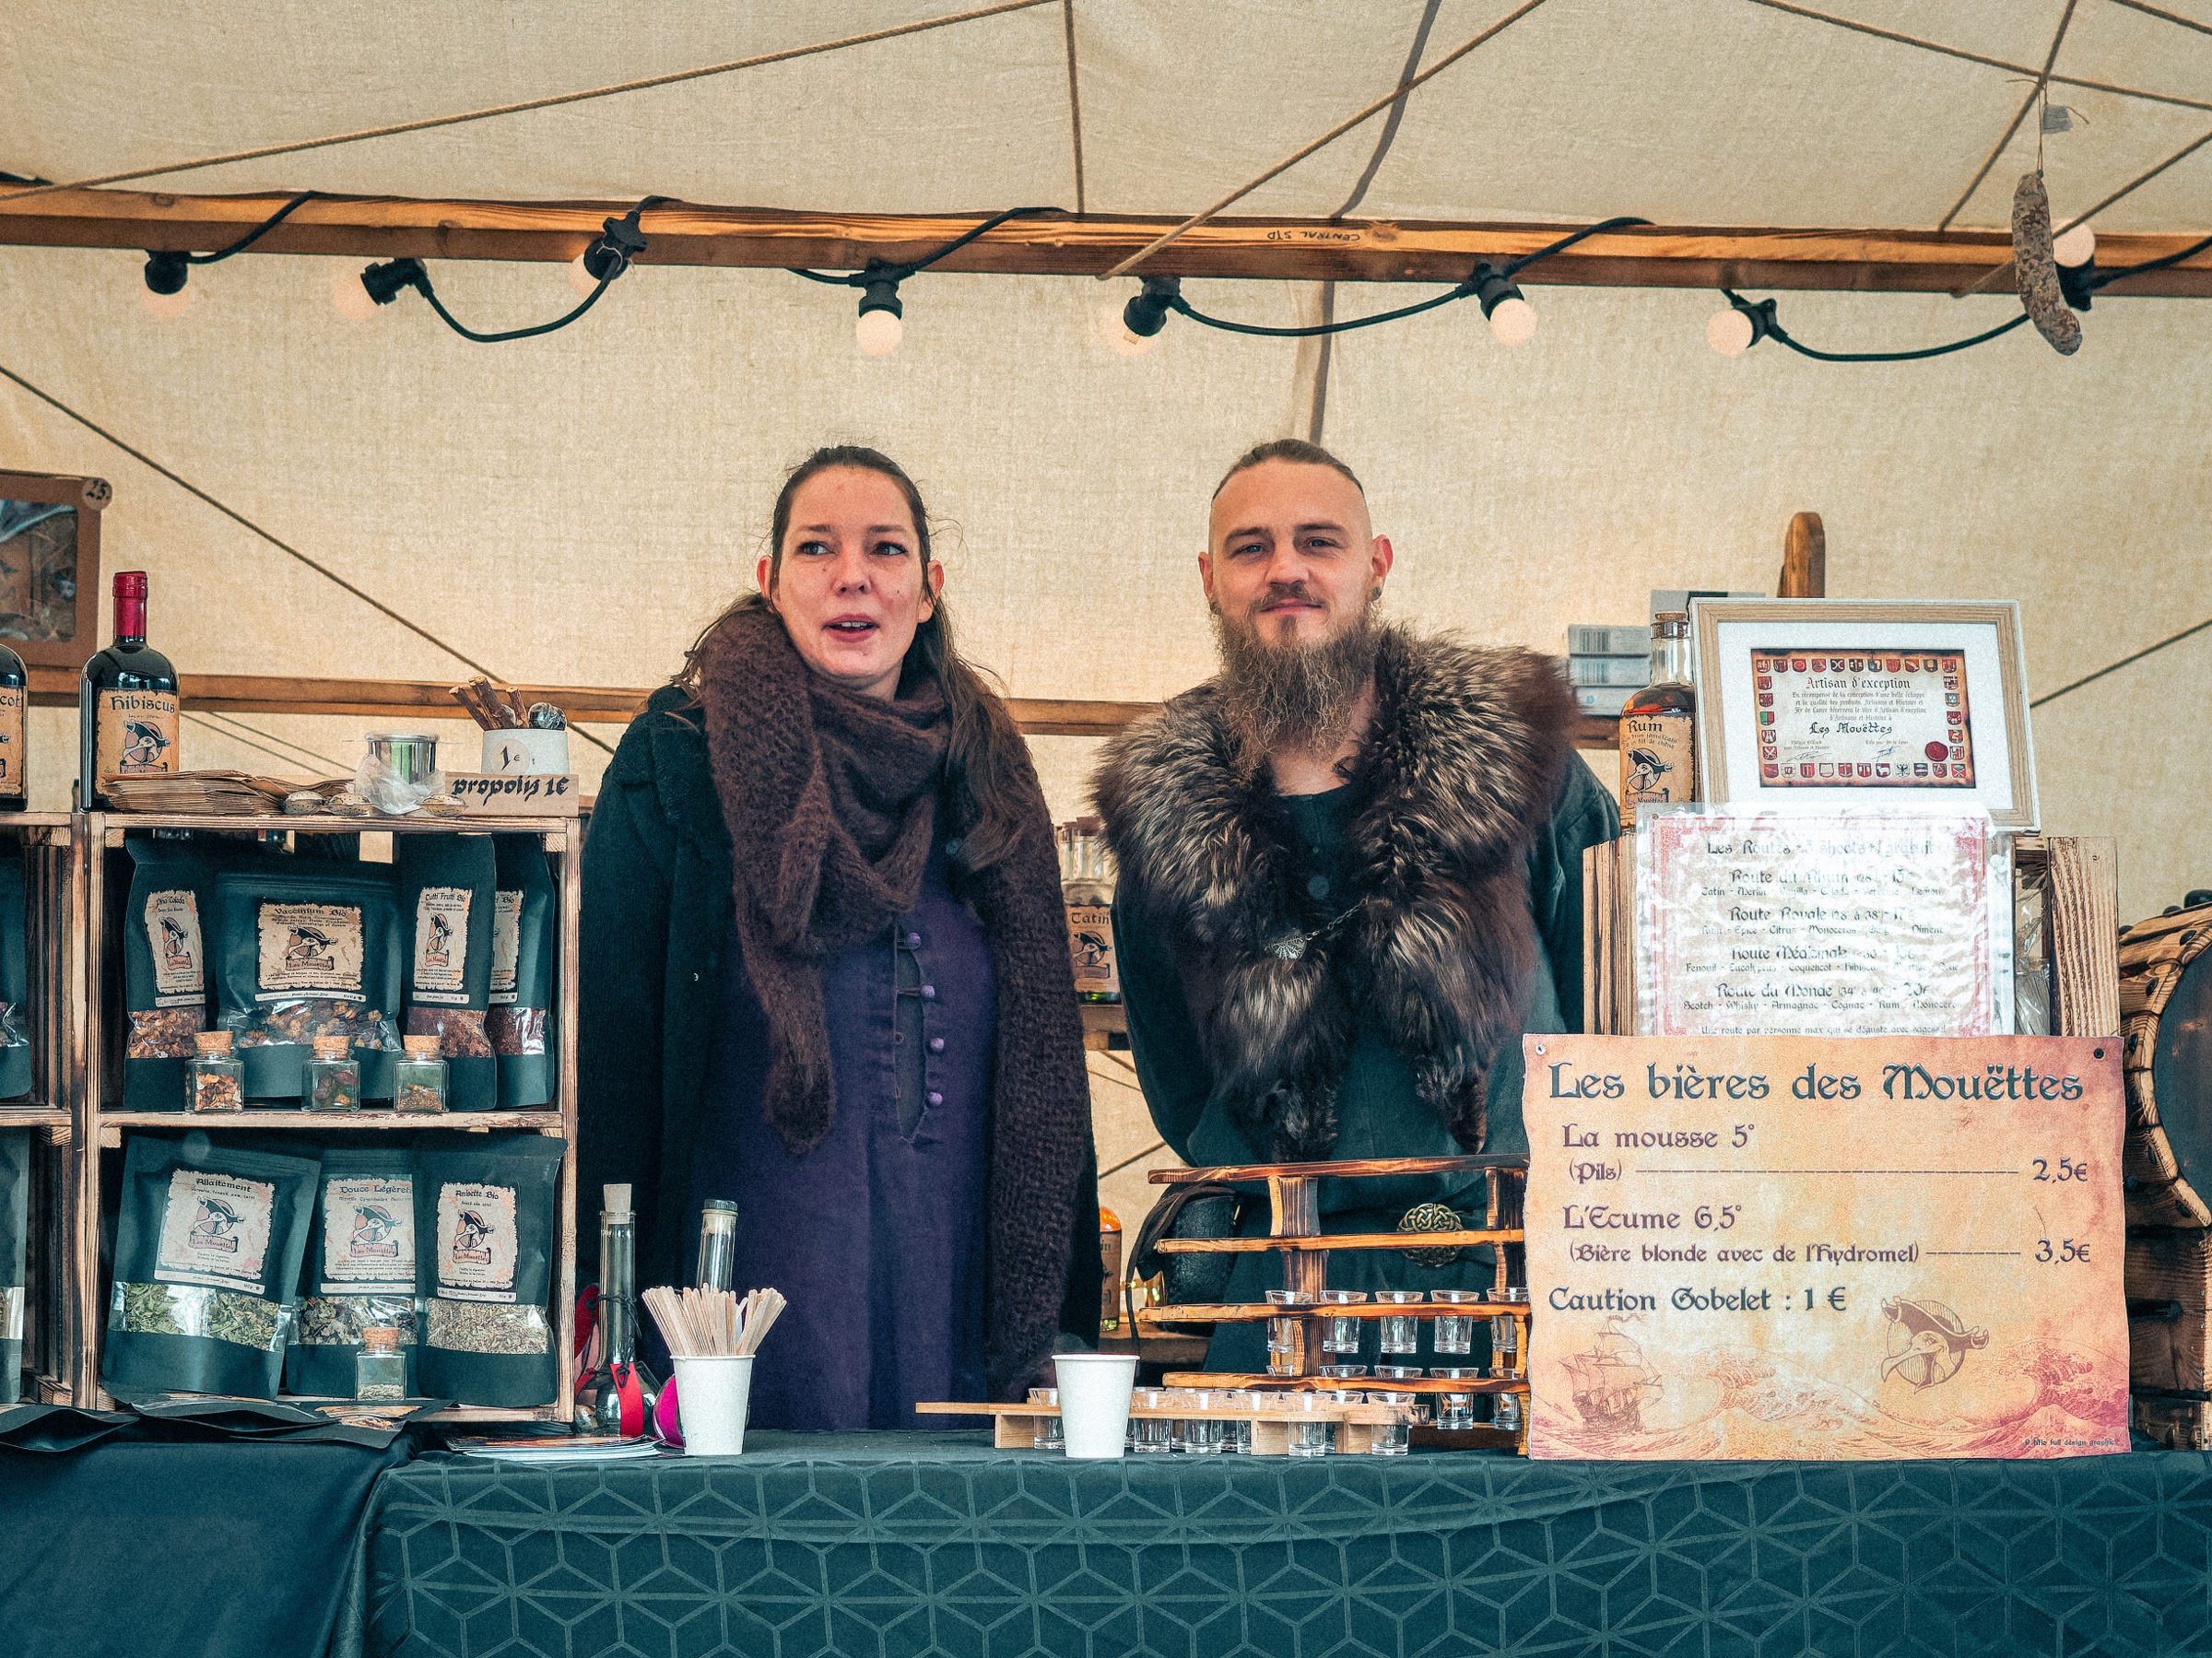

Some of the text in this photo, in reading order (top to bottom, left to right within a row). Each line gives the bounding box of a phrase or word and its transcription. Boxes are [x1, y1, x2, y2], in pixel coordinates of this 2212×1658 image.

[1299, 230, 1361, 241] CENTRAL
[1806, 676, 1911, 691] Artisan d'exception
[1626, 719, 1663, 734] Rum
[1809, 722, 1830, 738] Les
[451, 775, 570, 806] propolis 1€
[1708, 840, 1733, 855] Les
[1742, 839, 1791, 855] Routes
[1730, 868, 1772, 884] Route
[1779, 869, 1797, 884] du
[1701, 887, 1725, 896] Tatin
[1070, 911, 1110, 924] Tatin
[1729, 906, 1771, 922] Route
[1769, 924, 1796, 935] Citrus
[1732, 945, 1771, 959] Route
[1775, 945, 1848, 960] Médicinale
[1686, 962, 1717, 972] Fenouil
[1788, 962, 1832, 973] Coquelicot
[1715, 982, 1757, 998] Route
[1761, 982, 1779, 998] du
[1784, 982, 1832, 998] Monde
[1683, 1000, 1713, 1010] Scotch
[1725, 1001, 1759, 1012] Whisky
[1771, 1001, 1818, 1012] Armagnac
[1830, 1000, 1865, 1012] Cognac
[1878, 1000, 1900, 1010] Rum
[1701, 1025, 1718, 1035] Une
[1721, 1026, 1744, 1035] route
[1747, 1026, 1760, 1036] par
[1805, 1026, 1824, 1035] max
[1827, 1025, 1841, 1036] qui
[1855, 1024, 1888, 1036] déguste
[1890, 1026, 1909, 1034] avec
[1547, 1061, 2084, 1100] Les bières des Mouëttes
[1561, 1123, 1756, 1148] La mousse 5°
[1569, 1156, 2088, 1184] (Pils) 2,5€
[196, 1177, 253, 1193] Allaitement
[1562, 1204, 1742, 1232] L'Ecume 6,5°
[1570, 1240, 1631, 1263] (Bière
[1641, 1243, 1707, 1263] blonde
[1716, 1248, 1763, 1263] avec
[1771, 1243, 1796, 1263] de
[2034, 1238, 2091, 1265] 3,5€
[1548, 1286, 1847, 1311] Caution Gobelet 1 €
